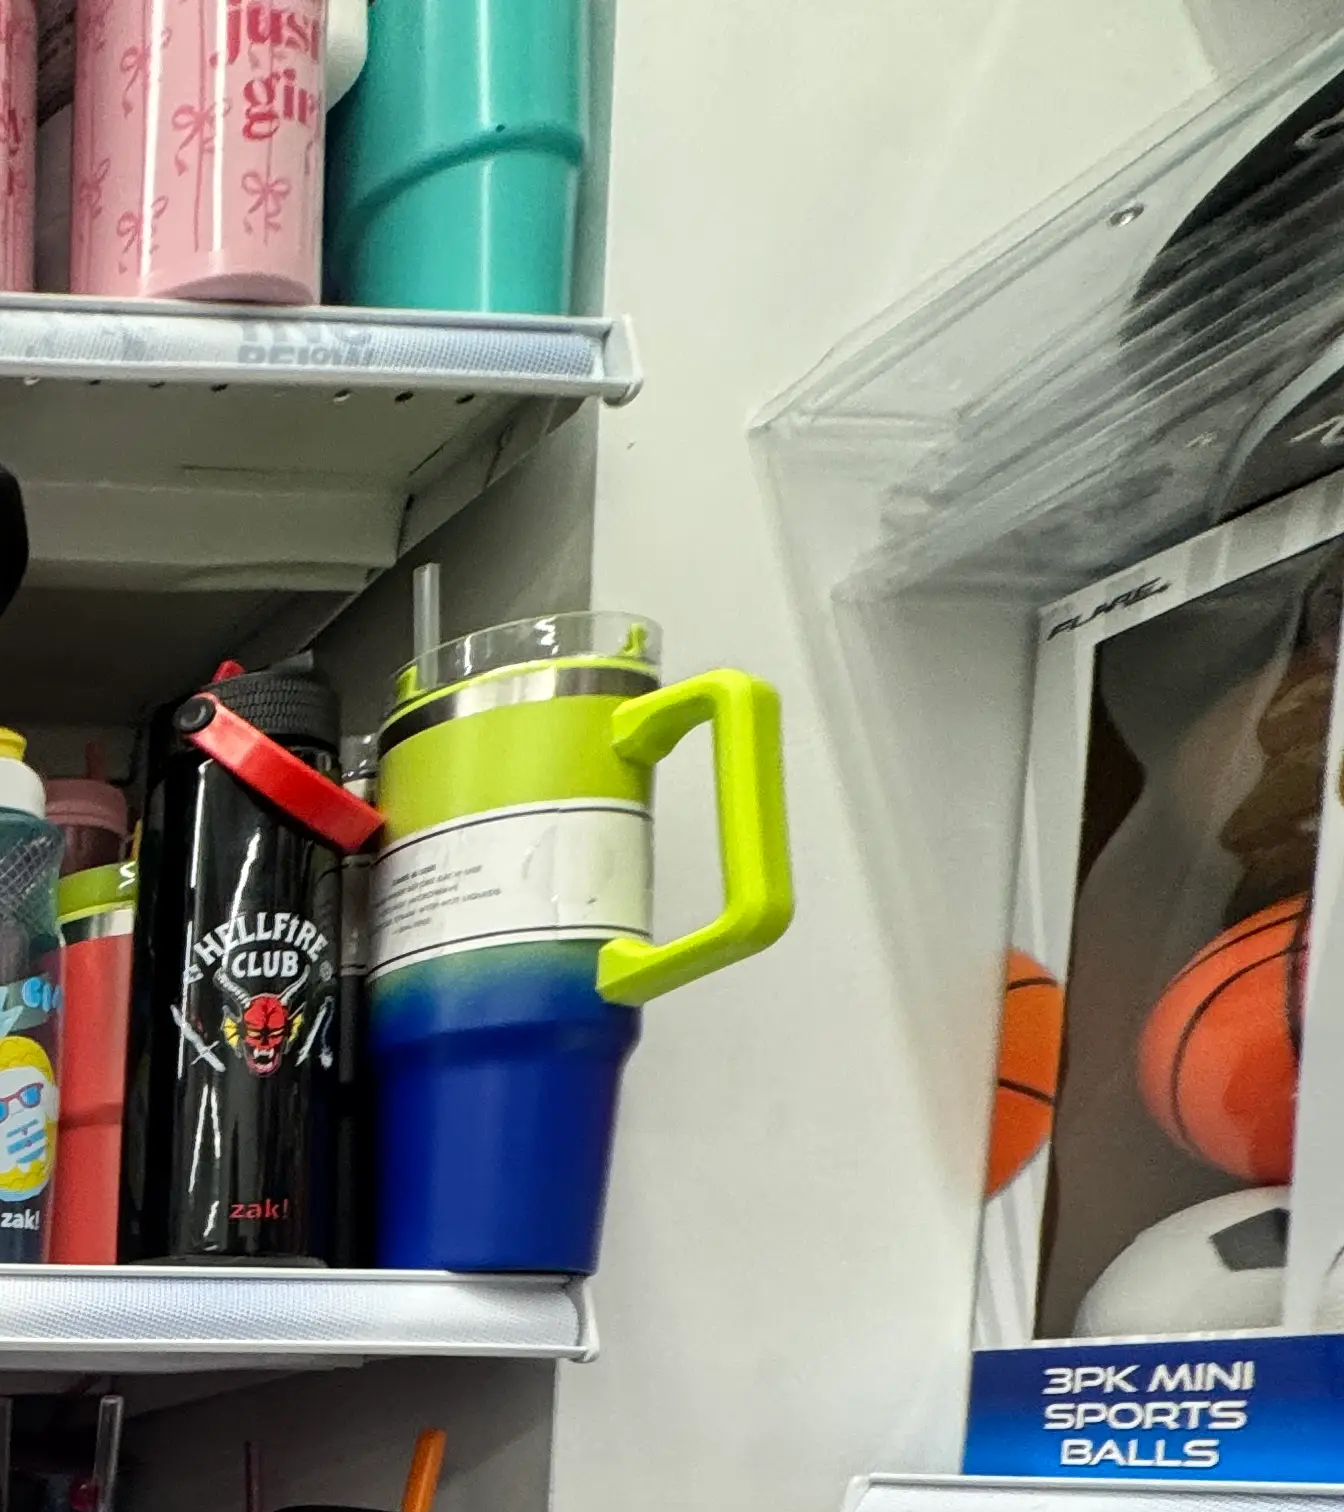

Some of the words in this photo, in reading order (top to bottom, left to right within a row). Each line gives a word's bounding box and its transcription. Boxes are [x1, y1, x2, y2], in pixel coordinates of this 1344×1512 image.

[193, 911, 329, 966] HELLFIRE
[231, 951, 300, 979] CLUB
[0, 1208, 41, 1230] zak!
[228, 1197, 290, 1221] zak!
[1041, 1364, 1141, 1396] 3PK
[1146, 1360, 1256, 1393] MINI
[1042, 1400, 1249, 1431] SPORTS
[1060, 1438, 1221, 1468] BALLS
